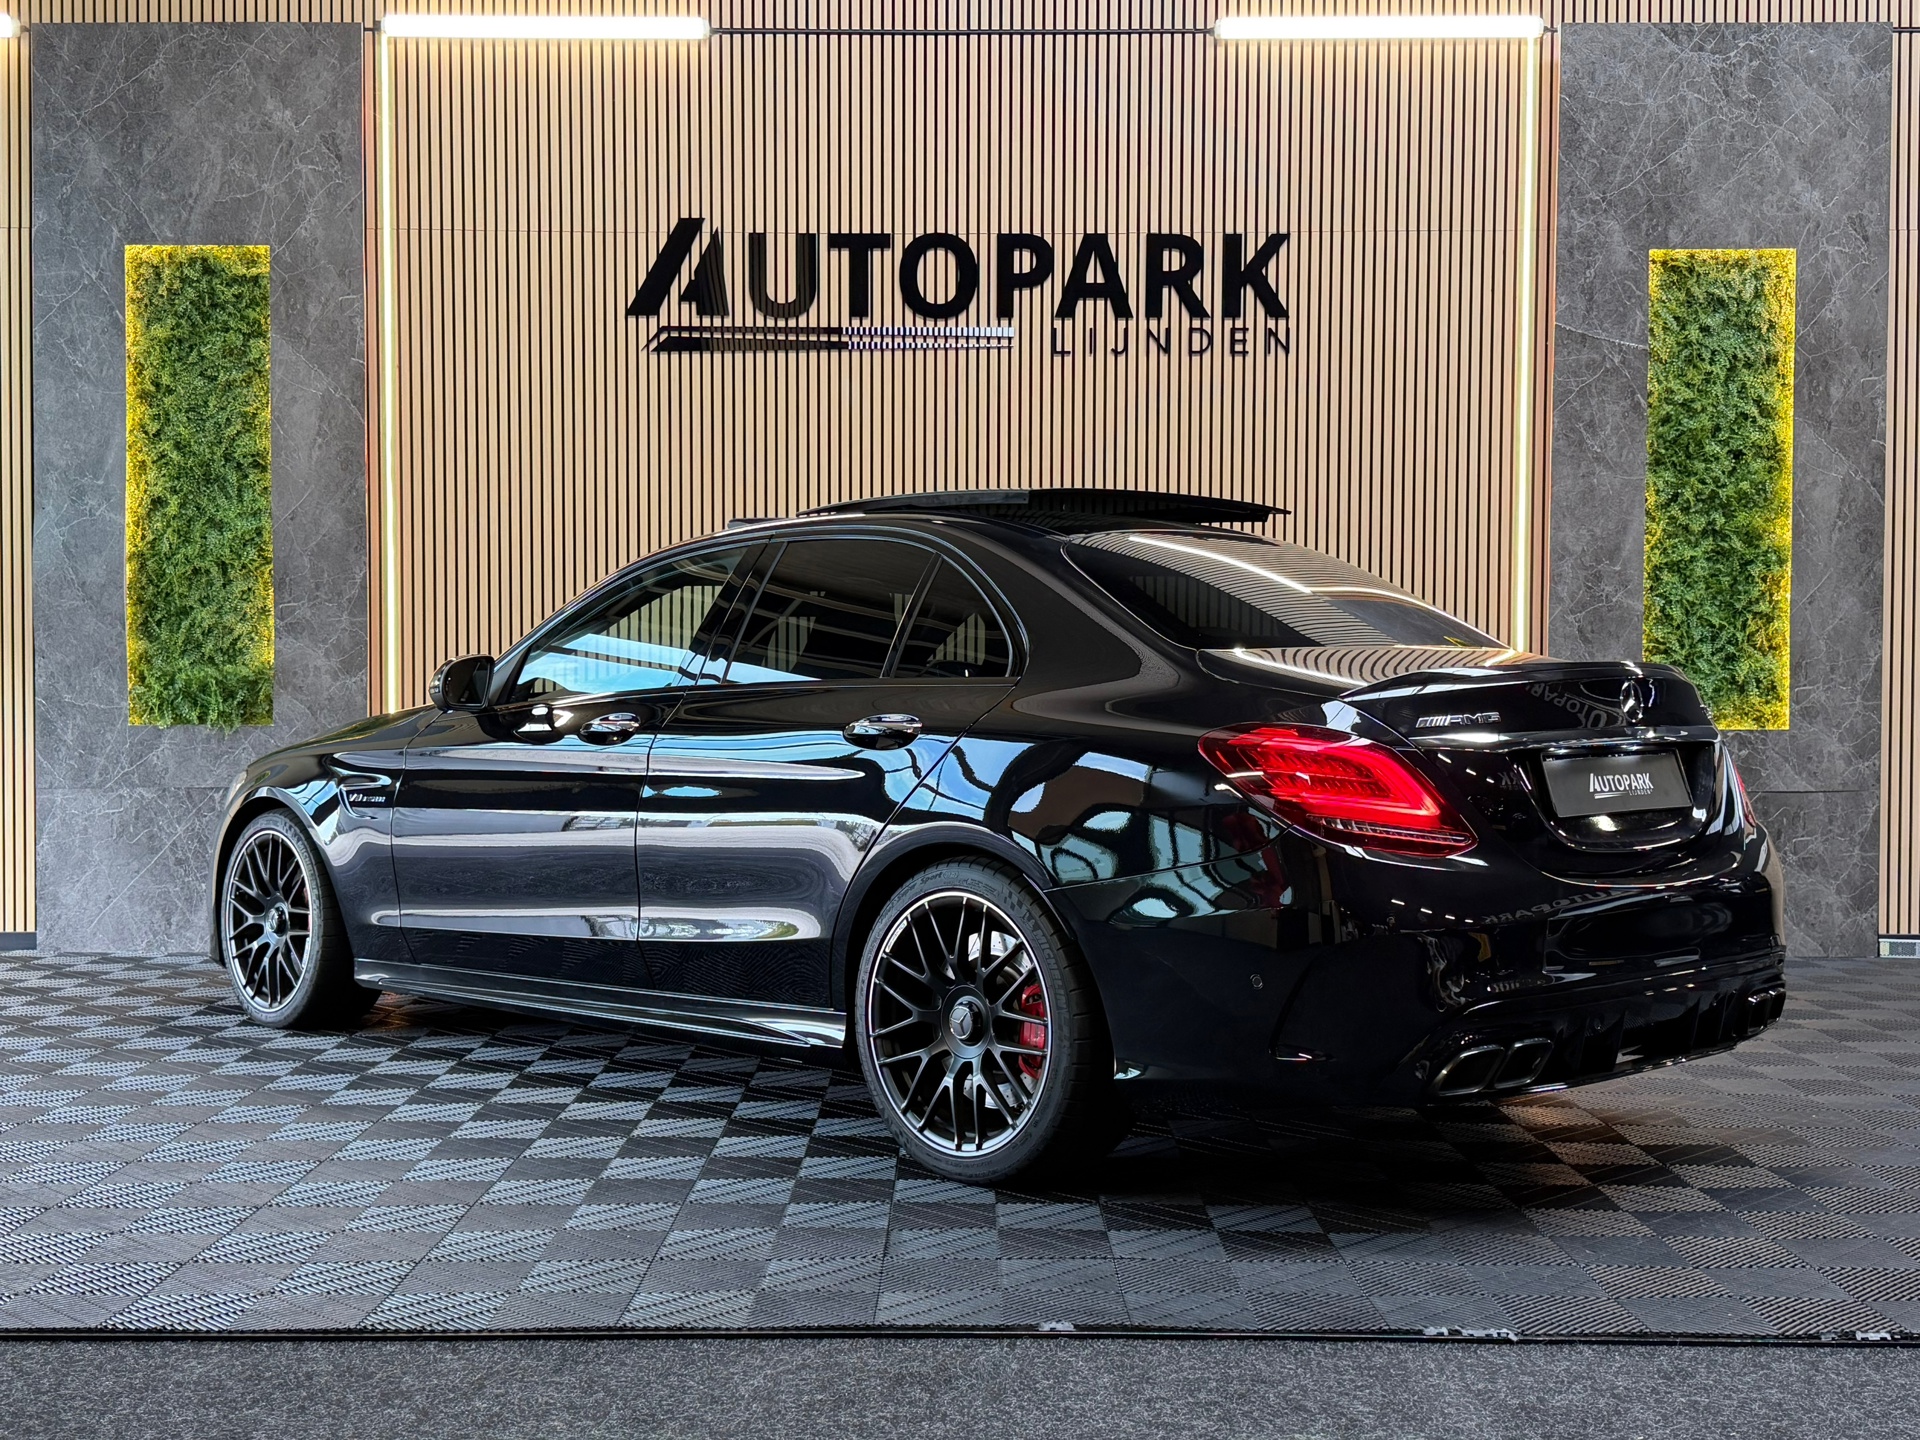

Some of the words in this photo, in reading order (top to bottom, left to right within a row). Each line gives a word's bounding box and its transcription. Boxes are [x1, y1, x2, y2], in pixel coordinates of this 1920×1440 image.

[625, 217, 1290, 319] AUTOPARK
[1052, 327, 1290, 357] LIJNDEN
[1445, 712, 1501, 727] AMG
[1589, 772, 1654, 792] AUTOPARK
[1033, 929, 1068, 1010] MICHELIN
